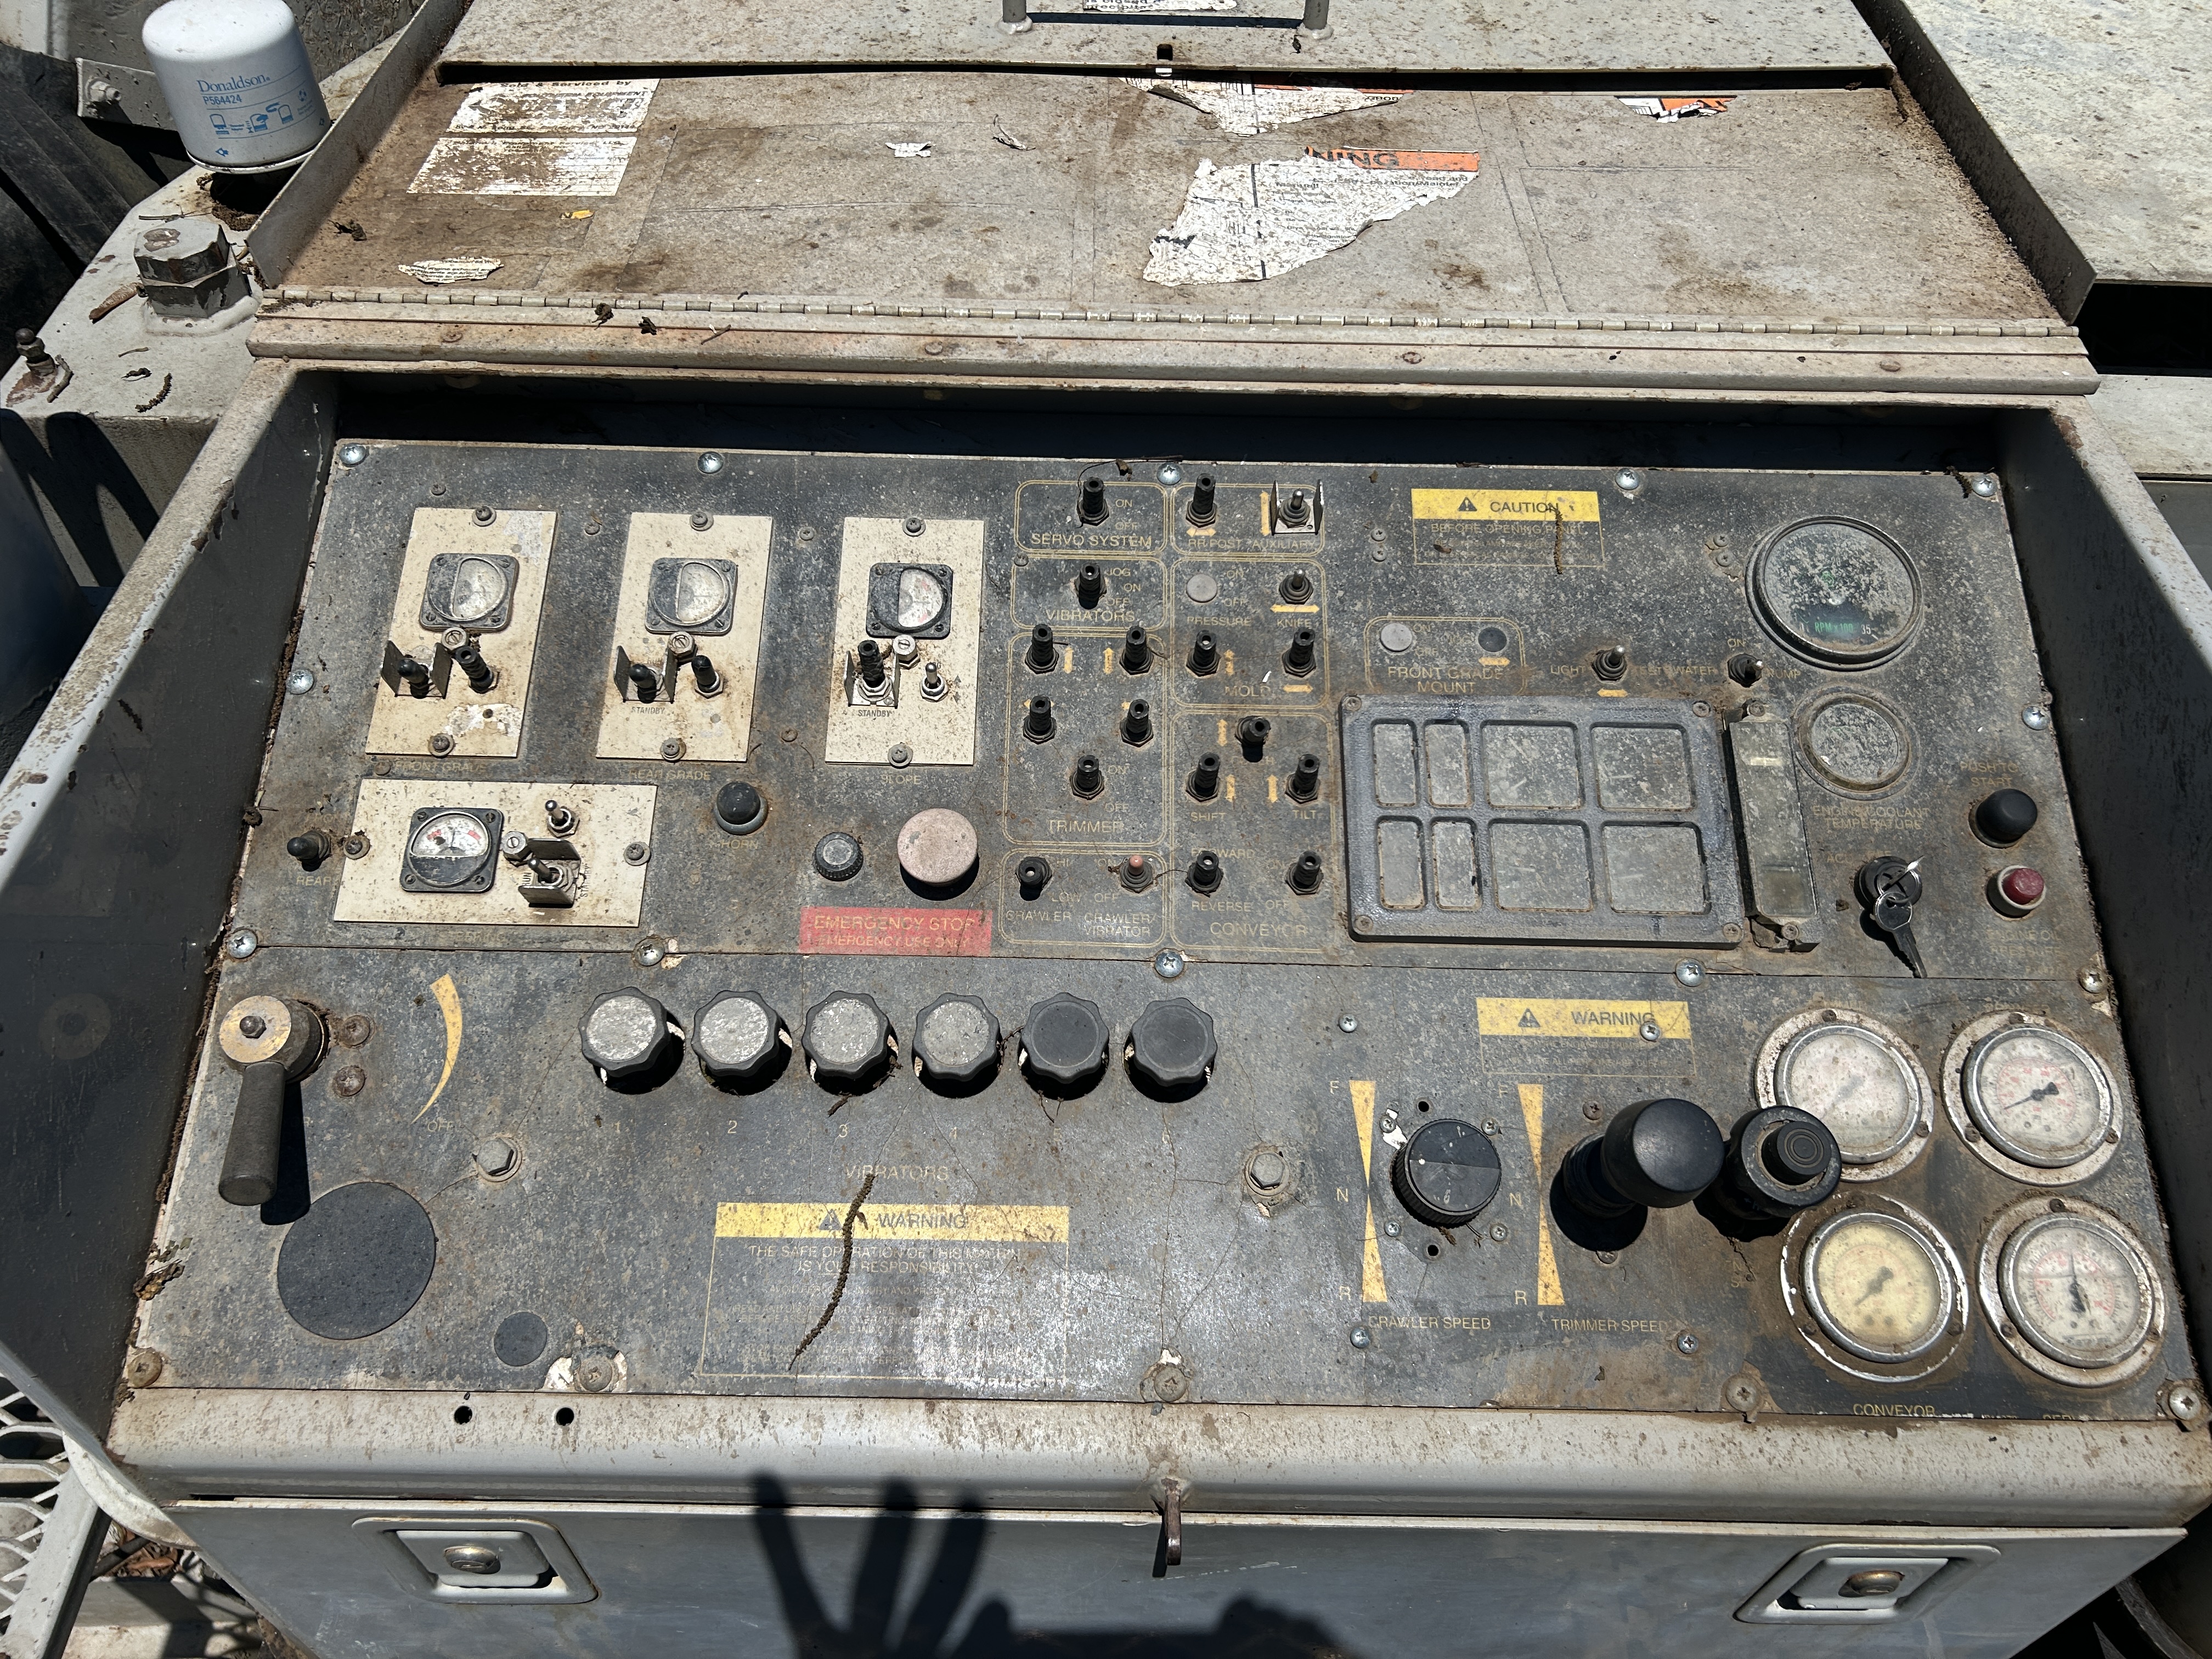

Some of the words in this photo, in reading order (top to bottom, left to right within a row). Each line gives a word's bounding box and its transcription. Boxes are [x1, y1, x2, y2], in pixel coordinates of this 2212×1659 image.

[196, 75, 267, 93] Donaldson
[202, 94, 242, 105] P564424
[1115, 499, 1133, 507] ON
[1489, 501, 1559, 513] CAUTION
[1115, 522, 1138, 531] OFF
[1431, 523, 1482, 533] BEFORE
[1485, 523, 1541, 534] OPENING
[1545, 524, 1584, 535] PNEL
[1031, 534, 1085, 546] SERVO
[1088, 534, 1153, 547] SYSTEM
[1188, 539, 1206, 548] RR
[1209, 539, 1243, 549] POST
[1251, 539, 1316, 549] AUXILIARY
[1105, 567, 1131, 577] JOG
[1226, 569, 1244, 579] ON
[1124, 583, 1142, 592] ON
[1105, 597, 1131, 606] OFF
[1224, 598, 1246, 607] OFF
[1046, 609, 1136, 622] VIBRATORS
[1187, 616, 1252, 627] PRESSURE
[1277, 618, 1313, 628] KNIFE
[1413, 624, 1431, 633] ON
[1814, 622, 1832, 633] RPM
[1839, 623, 1854, 633] 100
[1861, 624, 1871, 635] 35
[1727, 638, 1746, 648] ON
[1387, 666, 1442, 679] FRONT
[1448, 667, 1504, 680] GRADE
[1550, 665, 1586, 675] LIGHT
[1673, 665, 1716, 675] WATER
[1417, 681, 1476, 693] MOUNT
[631, 706, 665, 714] STANDBY
[858, 709, 891, 718] STANDBY
[1108, 765, 1127, 775] ON
[1960, 760, 1997, 772] PUSH
[1999, 761, 2019, 773] TO
[629, 770, 663, 779] REAR
[665, 771, 712, 781] GRADE
[1971, 776, 2012, 788] START
[1105, 803, 1130, 812] OFF
[1866, 806, 1930, 819] COOLANT
[1190, 811, 1227, 822] SHIFT
[1292, 810, 1317, 820] TILT
[1049, 820, 1125, 833] TRIMMER
[1825, 818, 1925, 830] TEMPERATURE
[720, 839, 759, 850] HORN
[1190, 848, 1256, 859] FWARD
[1057, 858, 1069, 867] HI
[1094, 893, 1120, 902] OFF
[1192, 900, 1252, 912] REVERSE
[1265, 899, 1289, 910] OFF
[1006, 910, 1071, 922] CRAWLER
[814, 915, 924, 930] EMERGENCY
[928, 917, 976, 932] STOP
[1210, 922, 1307, 937] CONVEYOR
[1084, 925, 1151, 937] VIBRATOR
[818, 934, 902, 946] EMERGENCY
[905, 935, 931, 946] USE
[934, 936, 972, 948] ONLY
[1571, 1011, 1655, 1026] WARNING
[1330, 1081, 1340, 1093] F
[1498, 1085, 1508, 1098] F
[427, 1121, 454, 1132] OFF
[727, 1120, 738, 1134] 2
[839, 1124, 848, 1138] 3
[845, 1165, 949, 1181] VIBRATORS
[1336, 1188, 1349, 1201] N
[1509, 1193, 1522, 1205] N
[878, 1212, 966, 1229] WARNING
[749, 1245, 777, 1257] THE
[781, 1245, 817, 1257] SAFE
[822, 1245, 903, 1259] OPRATION
[799, 1261, 812, 1272] IS
[818, 1261, 856, 1273] YOU
[1339, 1287, 1351, 1301] R
[1515, 1290, 1527, 1305] R
[1371, 1316, 1439, 1329] CRAWLER
[1443, 1316, 1491, 1330] SPEED
[1551, 1318, 1617, 1331] TRIMMER
[1621, 1319, 1668, 1333] SPEED
[1853, 1403, 1936, 1417] CONVEYOR
